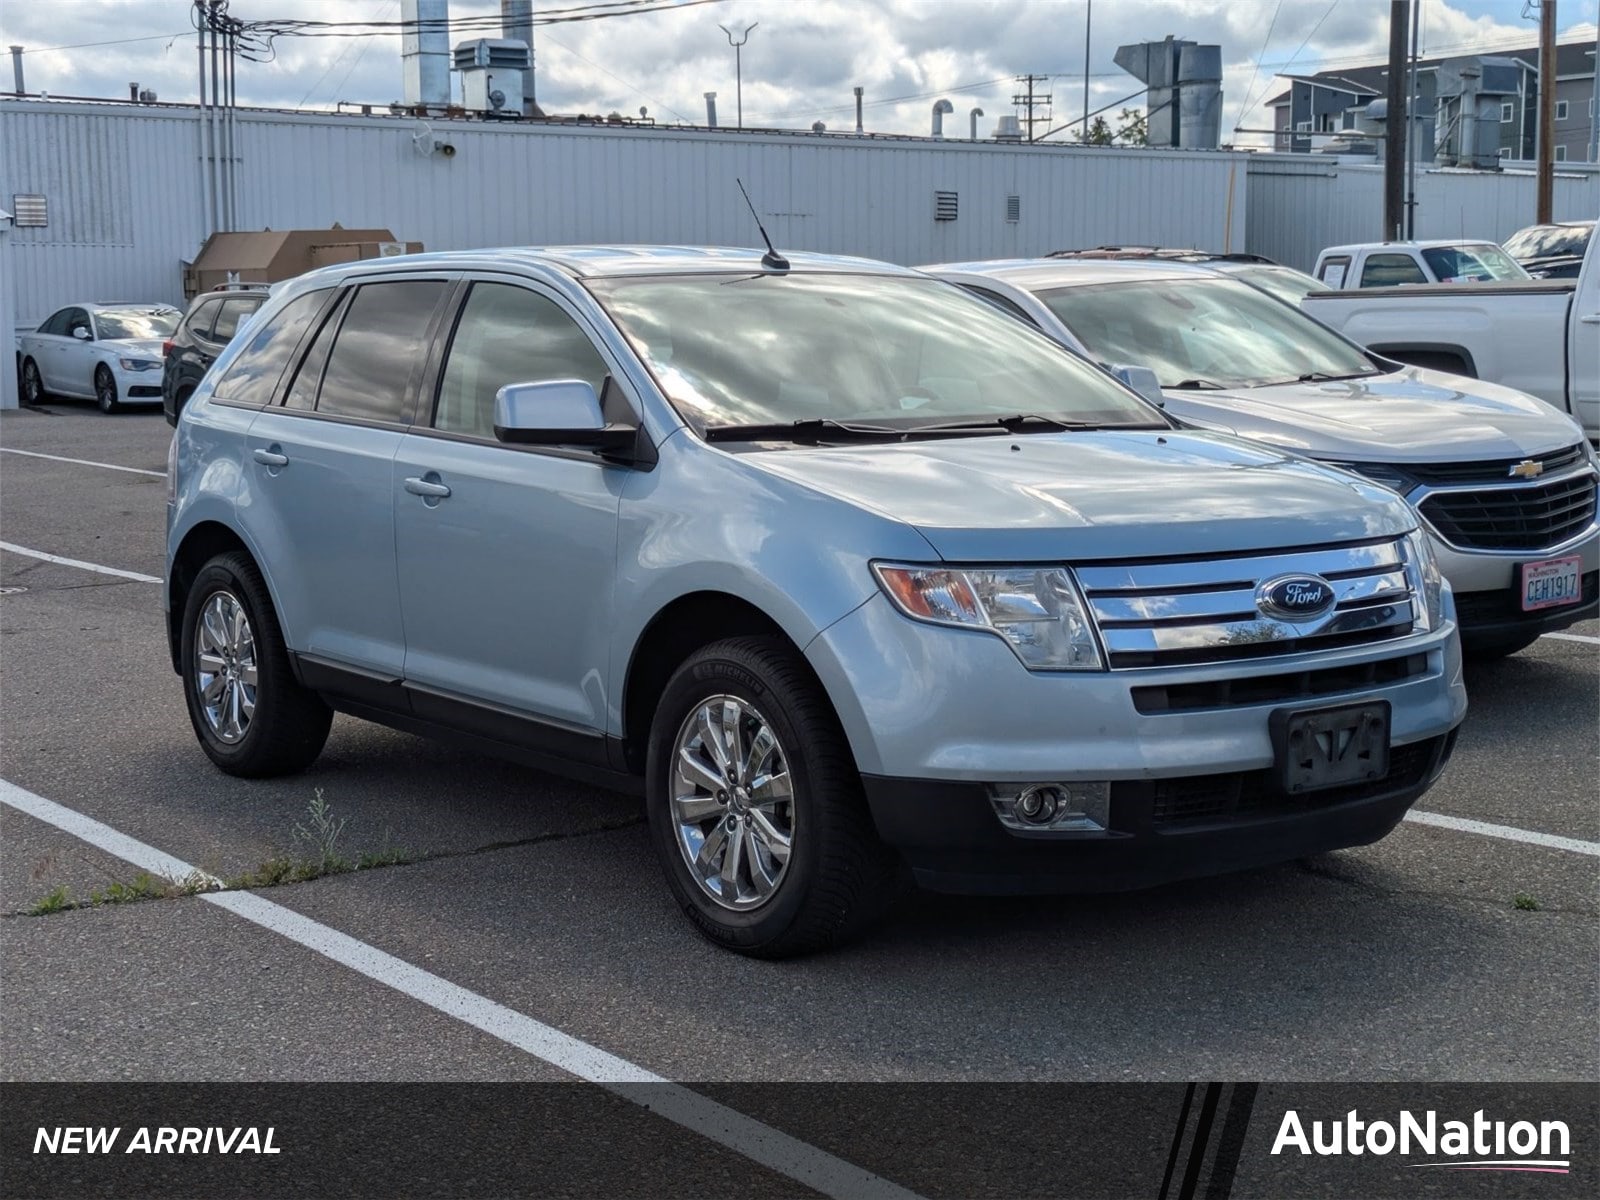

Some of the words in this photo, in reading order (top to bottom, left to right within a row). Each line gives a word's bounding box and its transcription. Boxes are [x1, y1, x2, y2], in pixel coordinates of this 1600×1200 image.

[1285, 582, 1323, 606] Ford
[1527, 573, 1577, 602] CEH1917
[714, 664, 763, 694] MICHELIN
